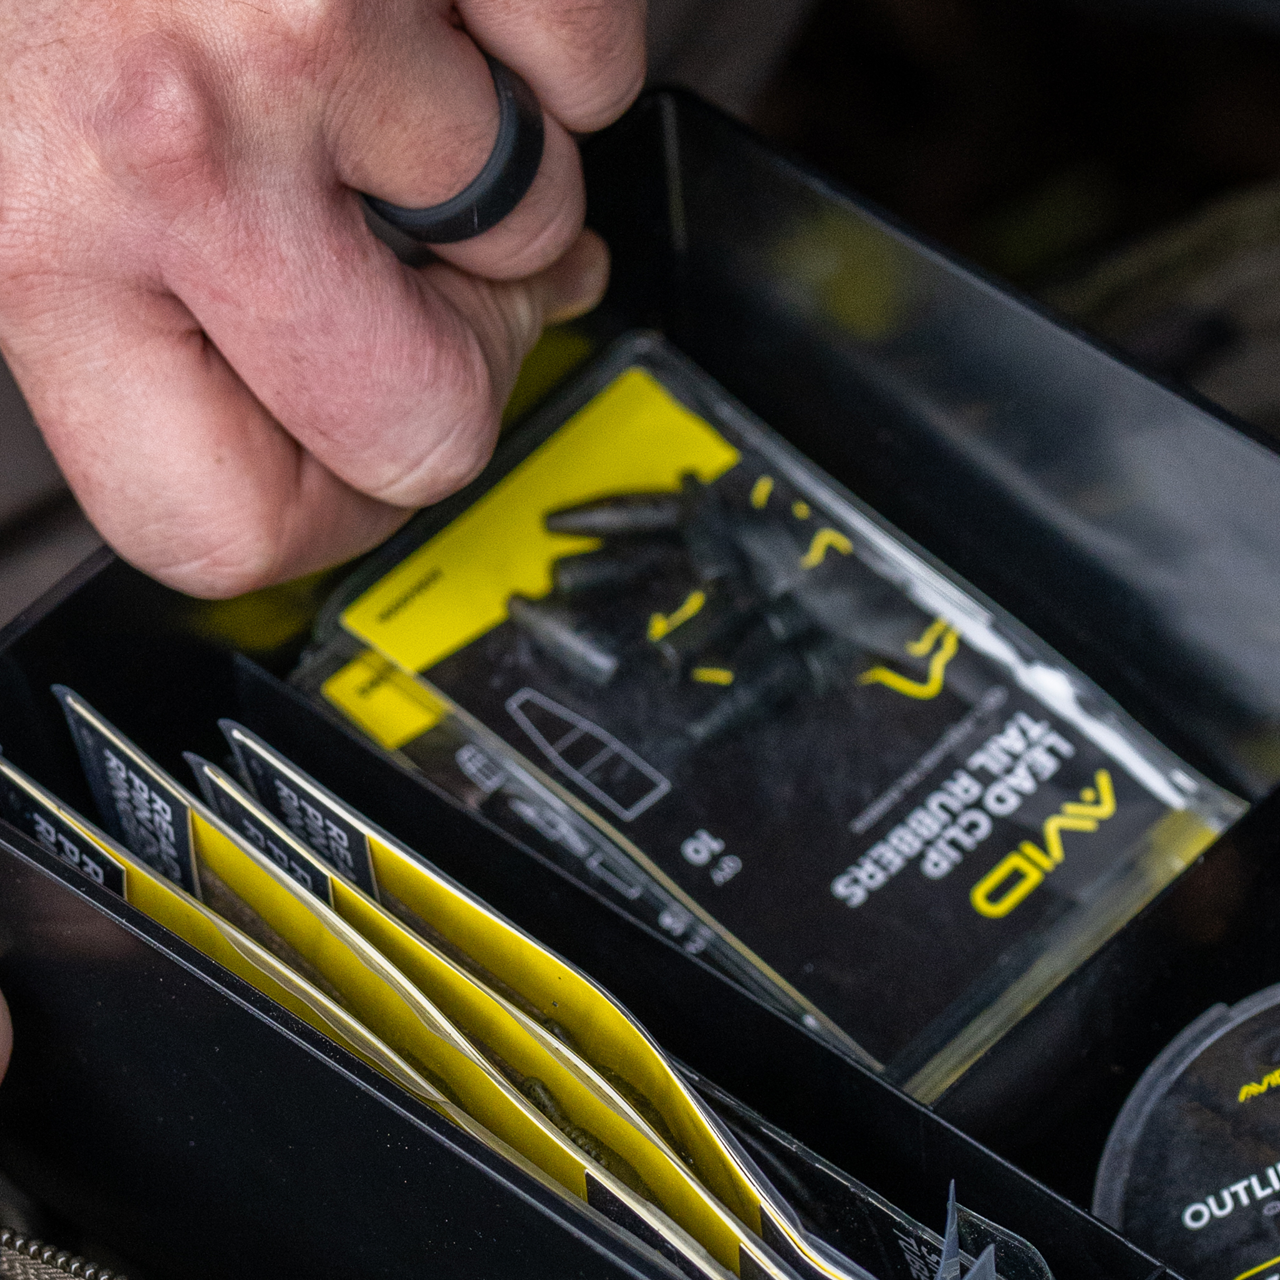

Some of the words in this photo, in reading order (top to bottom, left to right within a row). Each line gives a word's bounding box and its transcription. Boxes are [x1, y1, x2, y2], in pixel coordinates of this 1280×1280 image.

[966, 711, 1051, 776] TAIL
[983, 730, 1076, 818] LEAD
[681, 828, 726, 867] 10
[830, 768, 984, 908] RUBBERS
[921, 808, 994, 880] CLIP
[970, 768, 1117, 918] AVID
